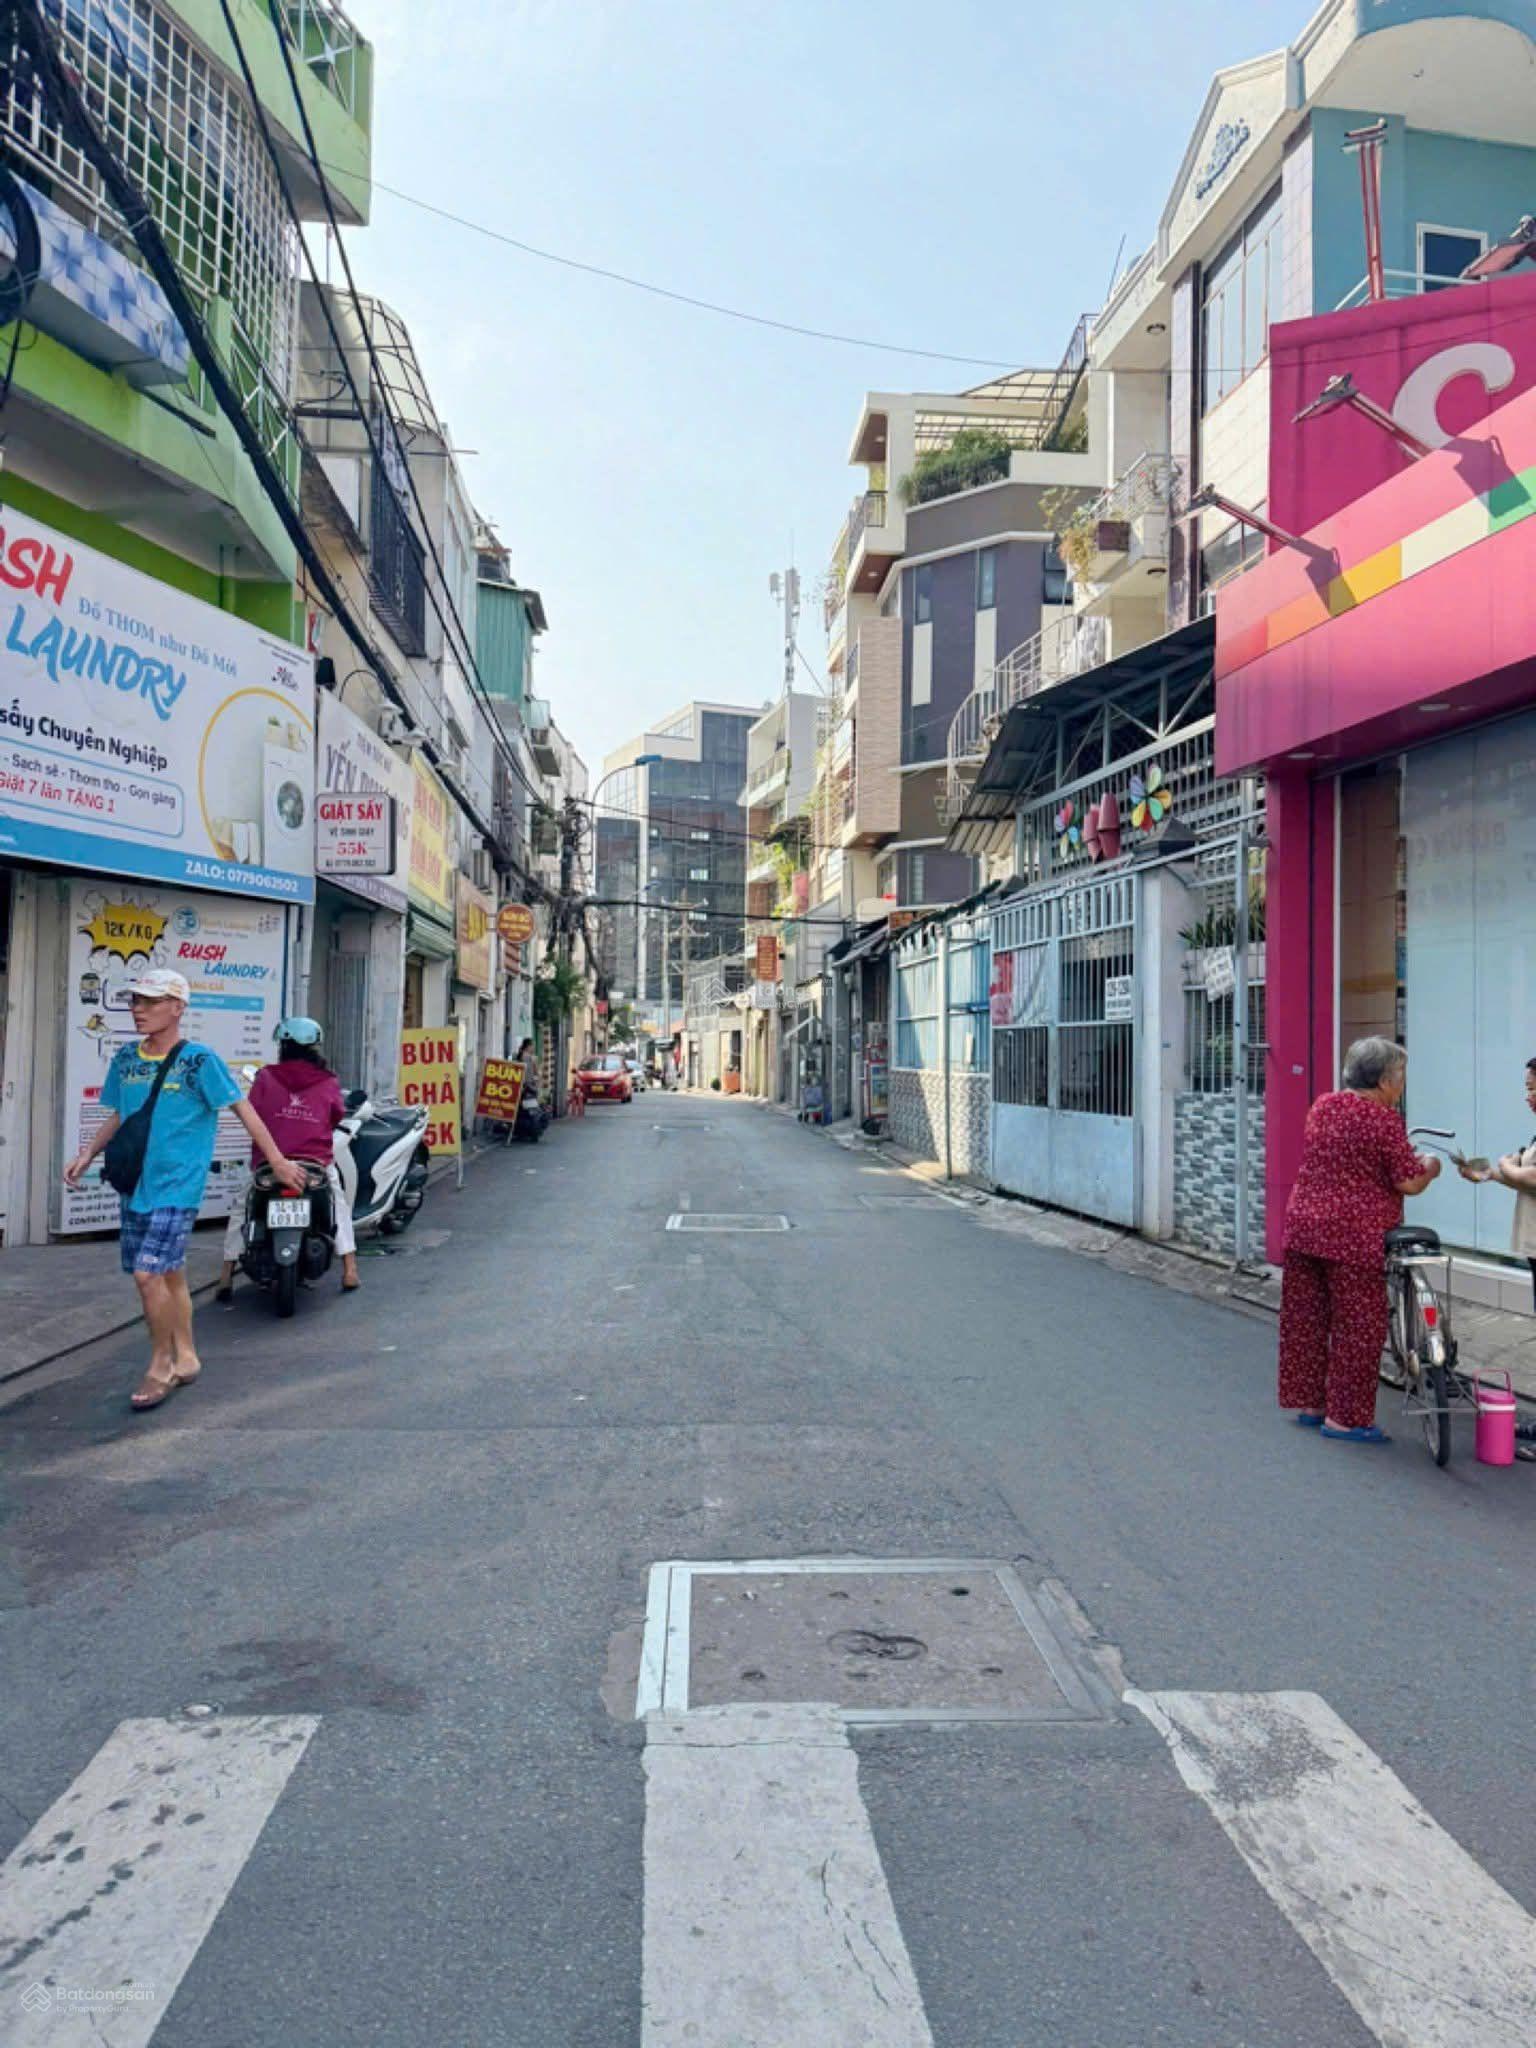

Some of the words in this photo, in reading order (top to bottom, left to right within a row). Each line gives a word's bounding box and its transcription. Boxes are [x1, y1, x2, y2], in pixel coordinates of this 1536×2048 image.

[0, 524, 74, 606] SH
[6, 603, 187, 722] LAUNDRY
[0, 698, 34, 736] sấy
[38, 716, 105, 752] Chuyên
[109, 736, 168, 773] Nghiệp
[12, 753, 42, 774] Sạch
[129, 784, 151, 801] Gọn
[29, 779, 37, 794] 7
[106, 798, 116, 813] 1
[320, 799, 354, 824] GIẶT
[357, 796, 383, 820] SẤY
[336, 841, 368, 855] 55K
[185, 860, 225, 880] ZALO:
[177, 941, 227, 961] RUSH
[204, 961, 271, 980] LAUNDRY
[402, 1037, 454, 1066] BÚN
[404, 1073, 456, 1106] CHẢ
